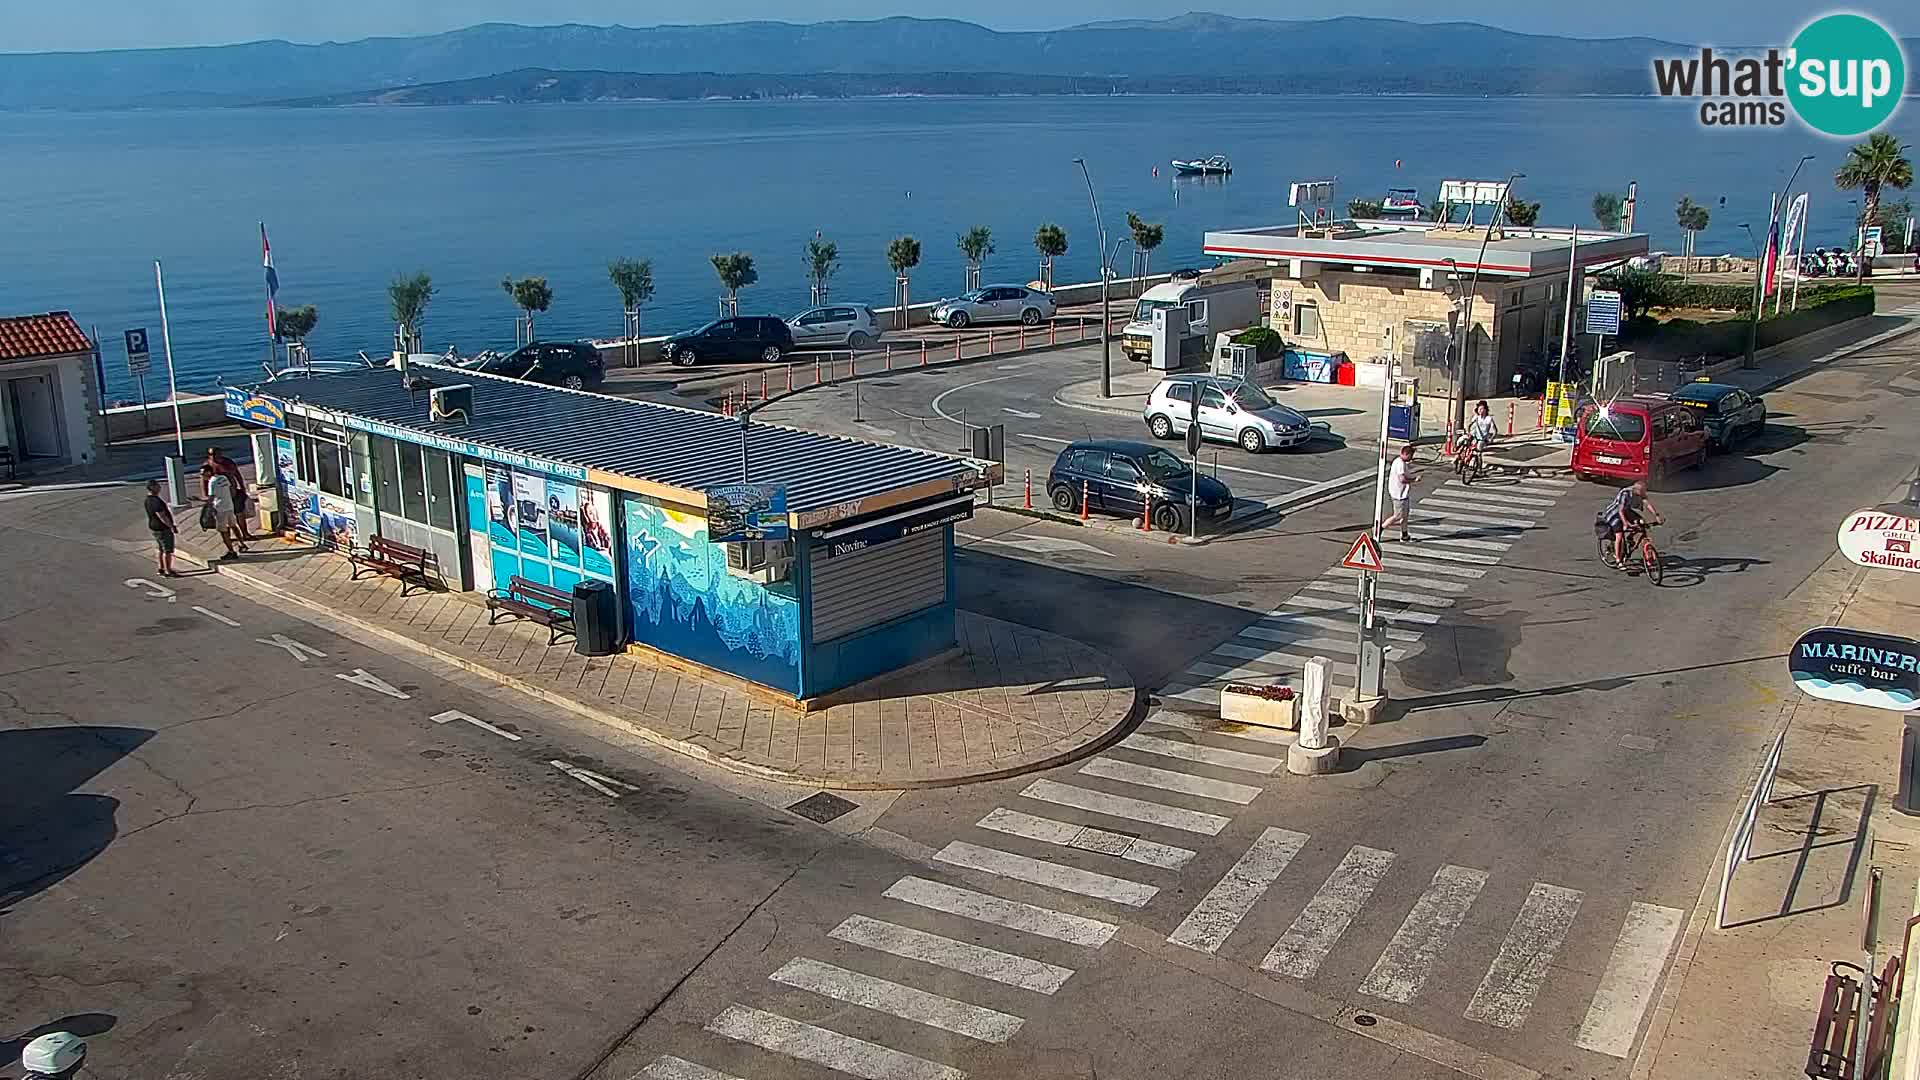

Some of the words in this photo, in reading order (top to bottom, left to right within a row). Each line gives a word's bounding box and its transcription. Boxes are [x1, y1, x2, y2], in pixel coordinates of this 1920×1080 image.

[129, 333, 142, 350] P
[437, 438, 468, 452] POSTAJA
[478, 446, 492, 458] BUS
[493, 449, 526, 465] STATION
[528, 458, 554, 472] TICKET
[556, 464, 582, 478] OFFICE
[1848, 515, 1920, 533] PIZZE
[1882, 530, 1918, 541] GRILL
[1829, 662, 1867, 676] caffe
[1870, 665, 1899, 681] bar
